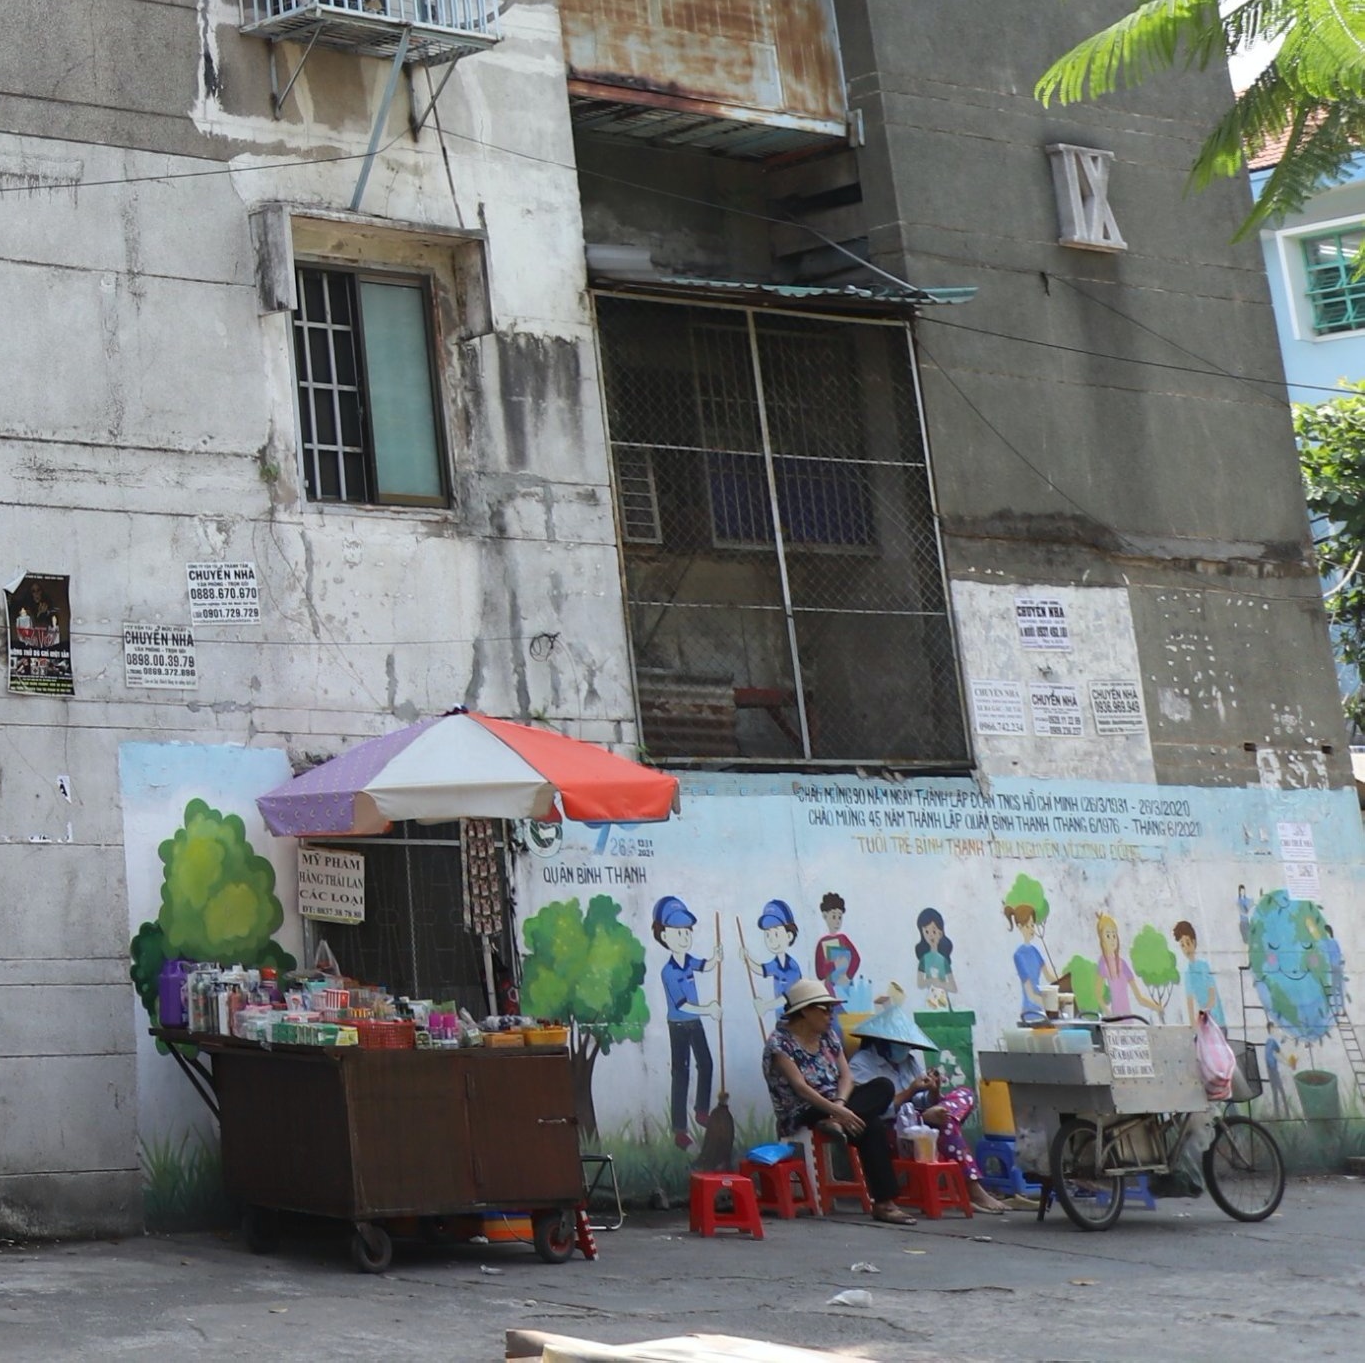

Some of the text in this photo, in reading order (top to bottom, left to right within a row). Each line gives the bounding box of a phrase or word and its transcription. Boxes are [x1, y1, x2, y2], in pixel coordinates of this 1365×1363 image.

[189, 566, 255, 581] CHUYỂN NHÀ
[190, 587, 257, 600] 0888.670.670
[202, 608, 259, 619] 0901.729.729
[125, 627, 194, 647] CHUYỂN NHÀ
[126, 653, 195, 668] 0898.00.39.79
[1032, 691, 1078, 707] CHUYỂN NHÀ
[1092, 687, 1139, 700] CHUYỂN NHÀ
[853, 787, 866, 805] 90
[996, 793, 1021, 811] TNCS
[1023, 788, 1036, 812] HỒ
[1037, 792, 1052, 811] CHÍ
[1053, 796, 1079, 812] MINH
[808, 807, 834, 826] CHÀO
[836, 805, 866, 828] MỪNG
[868, 810, 882, 828] 45
[884, 809, 906, 828] NĂM
[907, 808, 942, 829] THÀNH
[991, 812, 1015, 831] BÌNH
[1015, 815, 1050, 834] THẠNH
[1089, 817, 1121, 834] 6/1976
[1131, 816, 1166, 836] THÁNG
[302, 852, 320, 866] MỸ
[299, 869, 363, 889] HÀNG THÁI LAN
[543, 862, 647, 889] QUẬN BÌNH THẠNH
[299, 888, 363, 907] CÁC LOẠI
